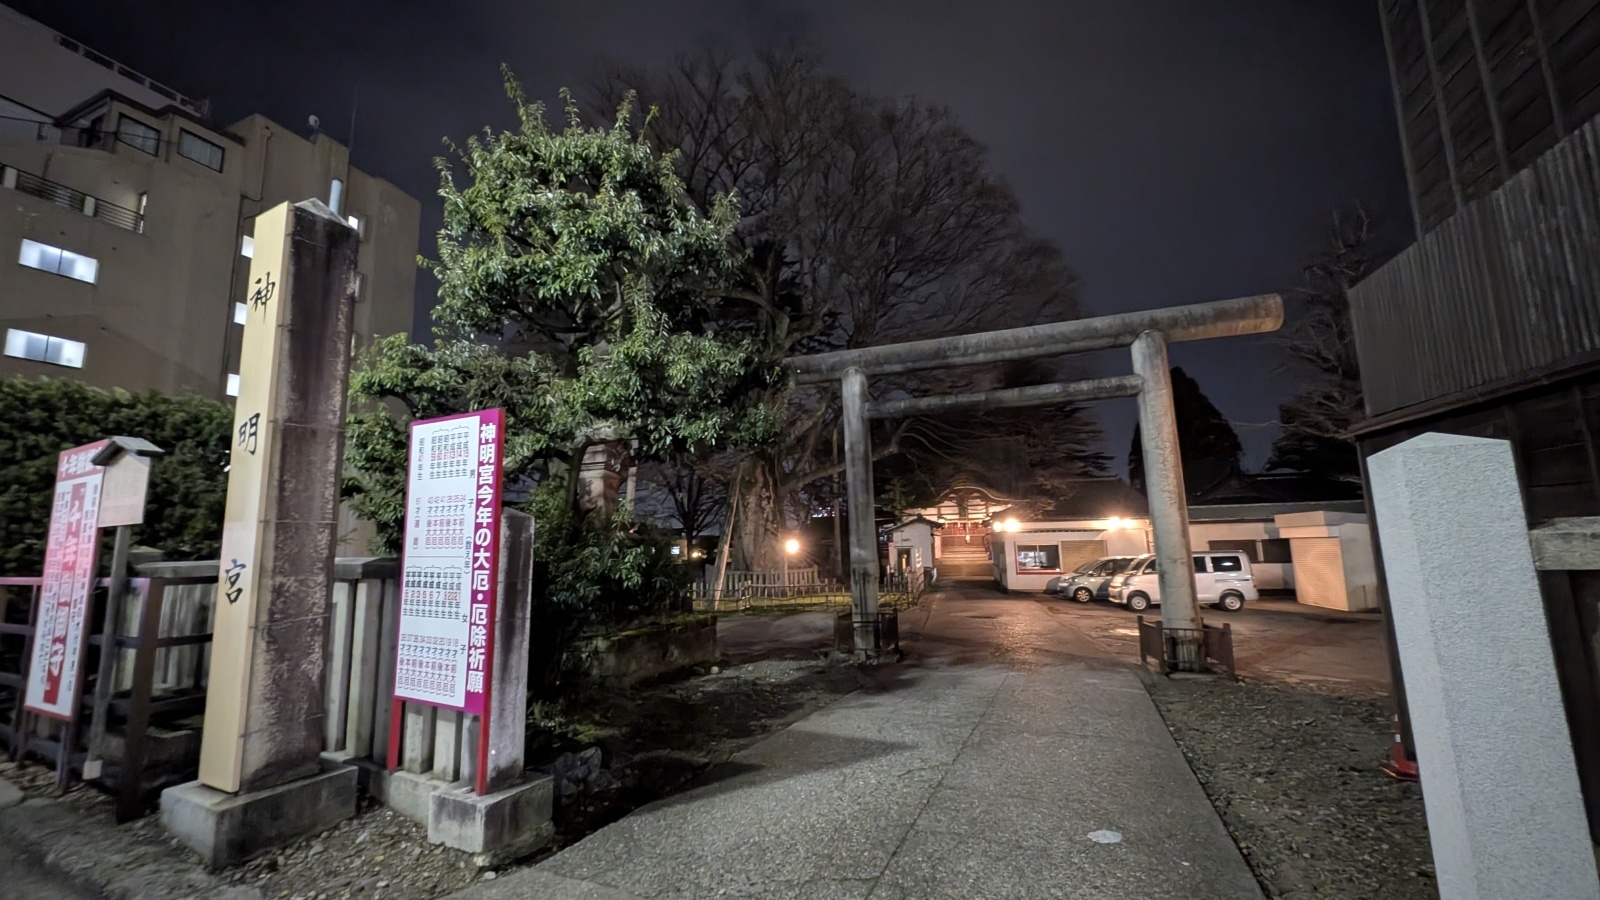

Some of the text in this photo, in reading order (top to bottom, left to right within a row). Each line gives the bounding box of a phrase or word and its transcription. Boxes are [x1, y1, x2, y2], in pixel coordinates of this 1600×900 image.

[225, 271, 276, 605] 神明宮
[467, 423, 496, 693] 神明宮今年の大厄・厄除祈願
